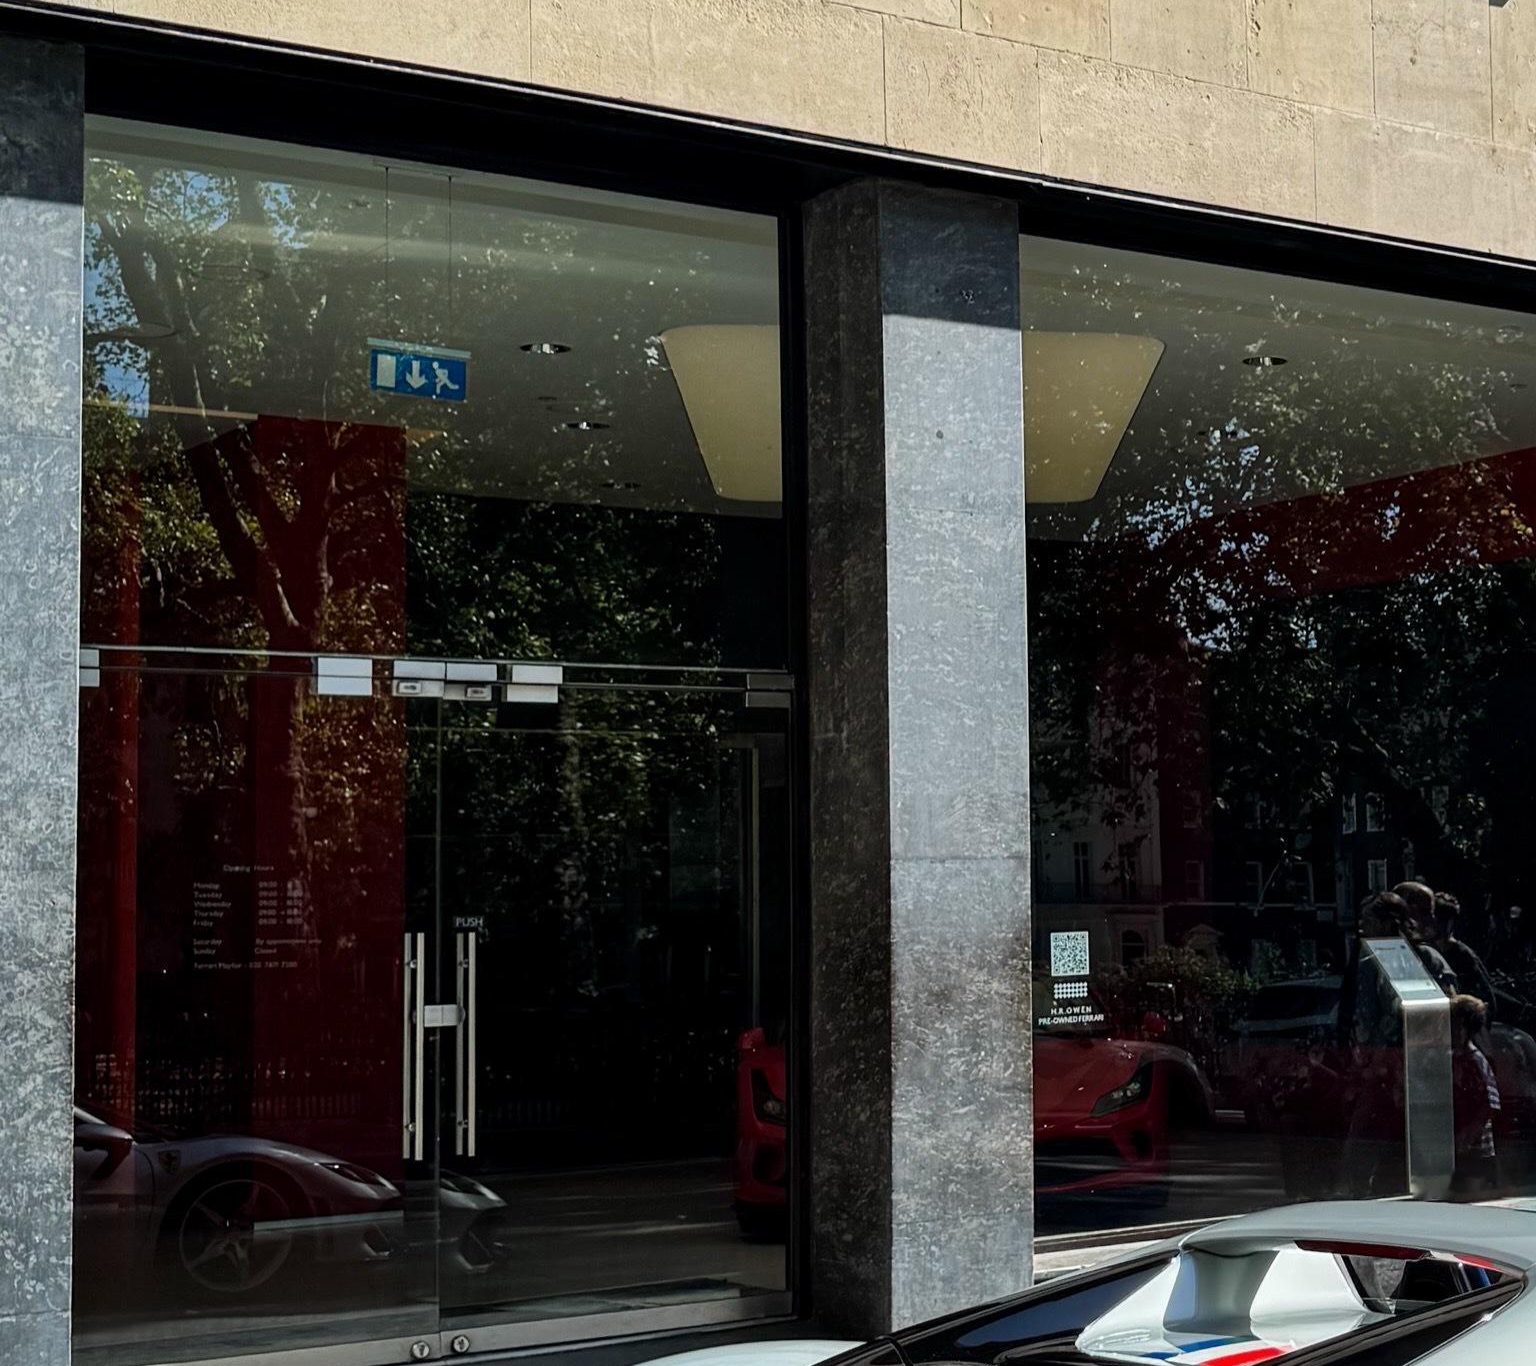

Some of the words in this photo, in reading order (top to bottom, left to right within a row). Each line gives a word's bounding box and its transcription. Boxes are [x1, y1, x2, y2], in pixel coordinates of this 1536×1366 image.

[455, 917, 483, 927] PUSH
[1038, 1015, 1078, 1025] PRE-OWNED
[1078, 1013, 1105, 1022] FERRARI
